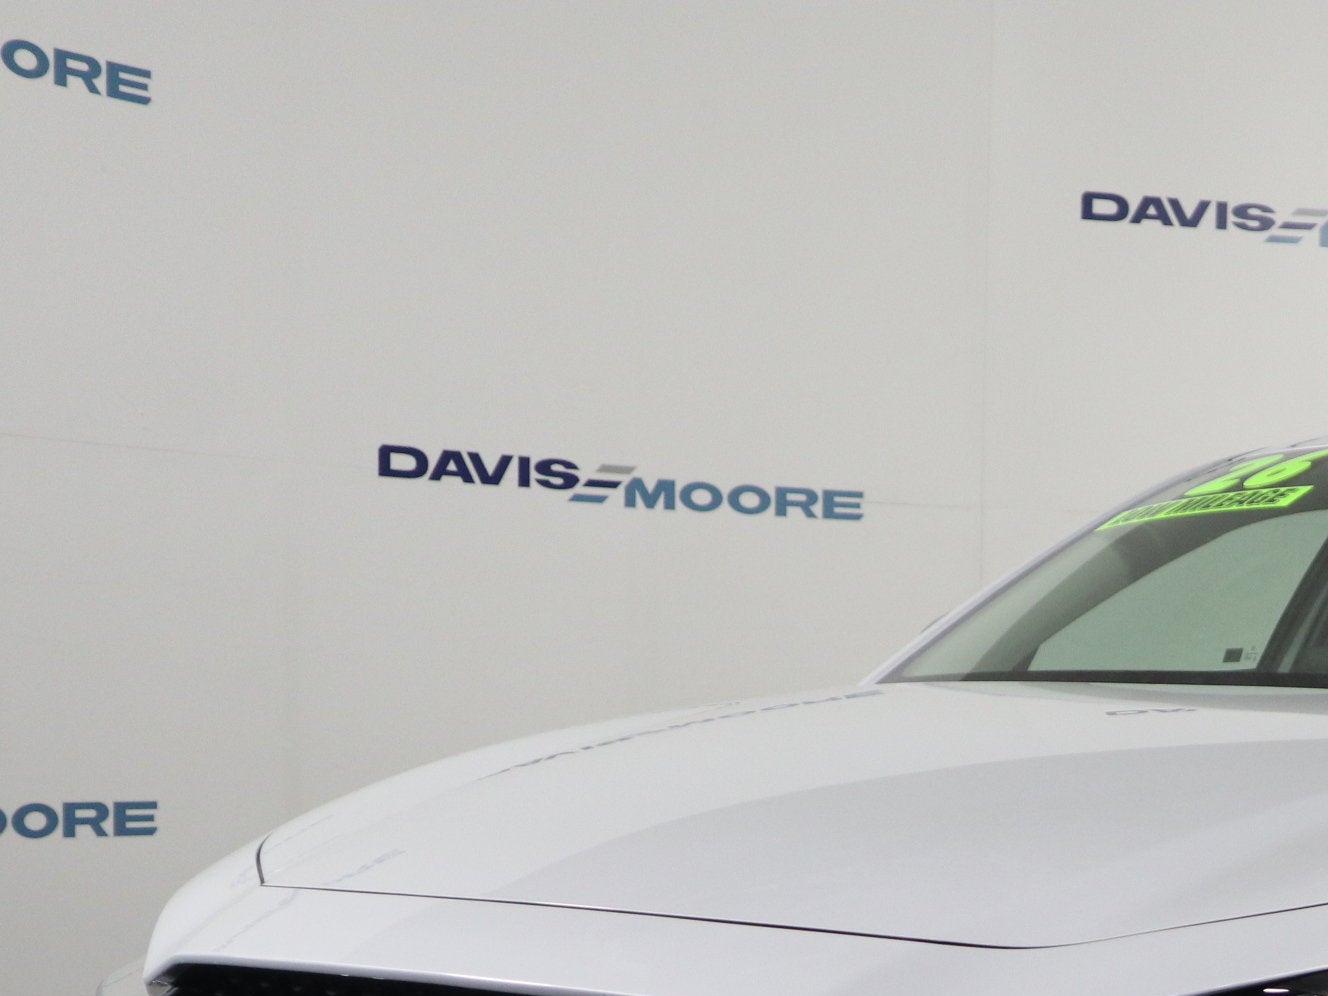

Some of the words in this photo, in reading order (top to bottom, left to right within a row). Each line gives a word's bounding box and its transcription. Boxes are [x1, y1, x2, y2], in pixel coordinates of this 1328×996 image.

[1081, 190, 1276, 231] DAVIS
[378, 444, 581, 490] DAVIS
[624, 476, 864, 521] MOORE
[0, 801, 157, 839] ORE
